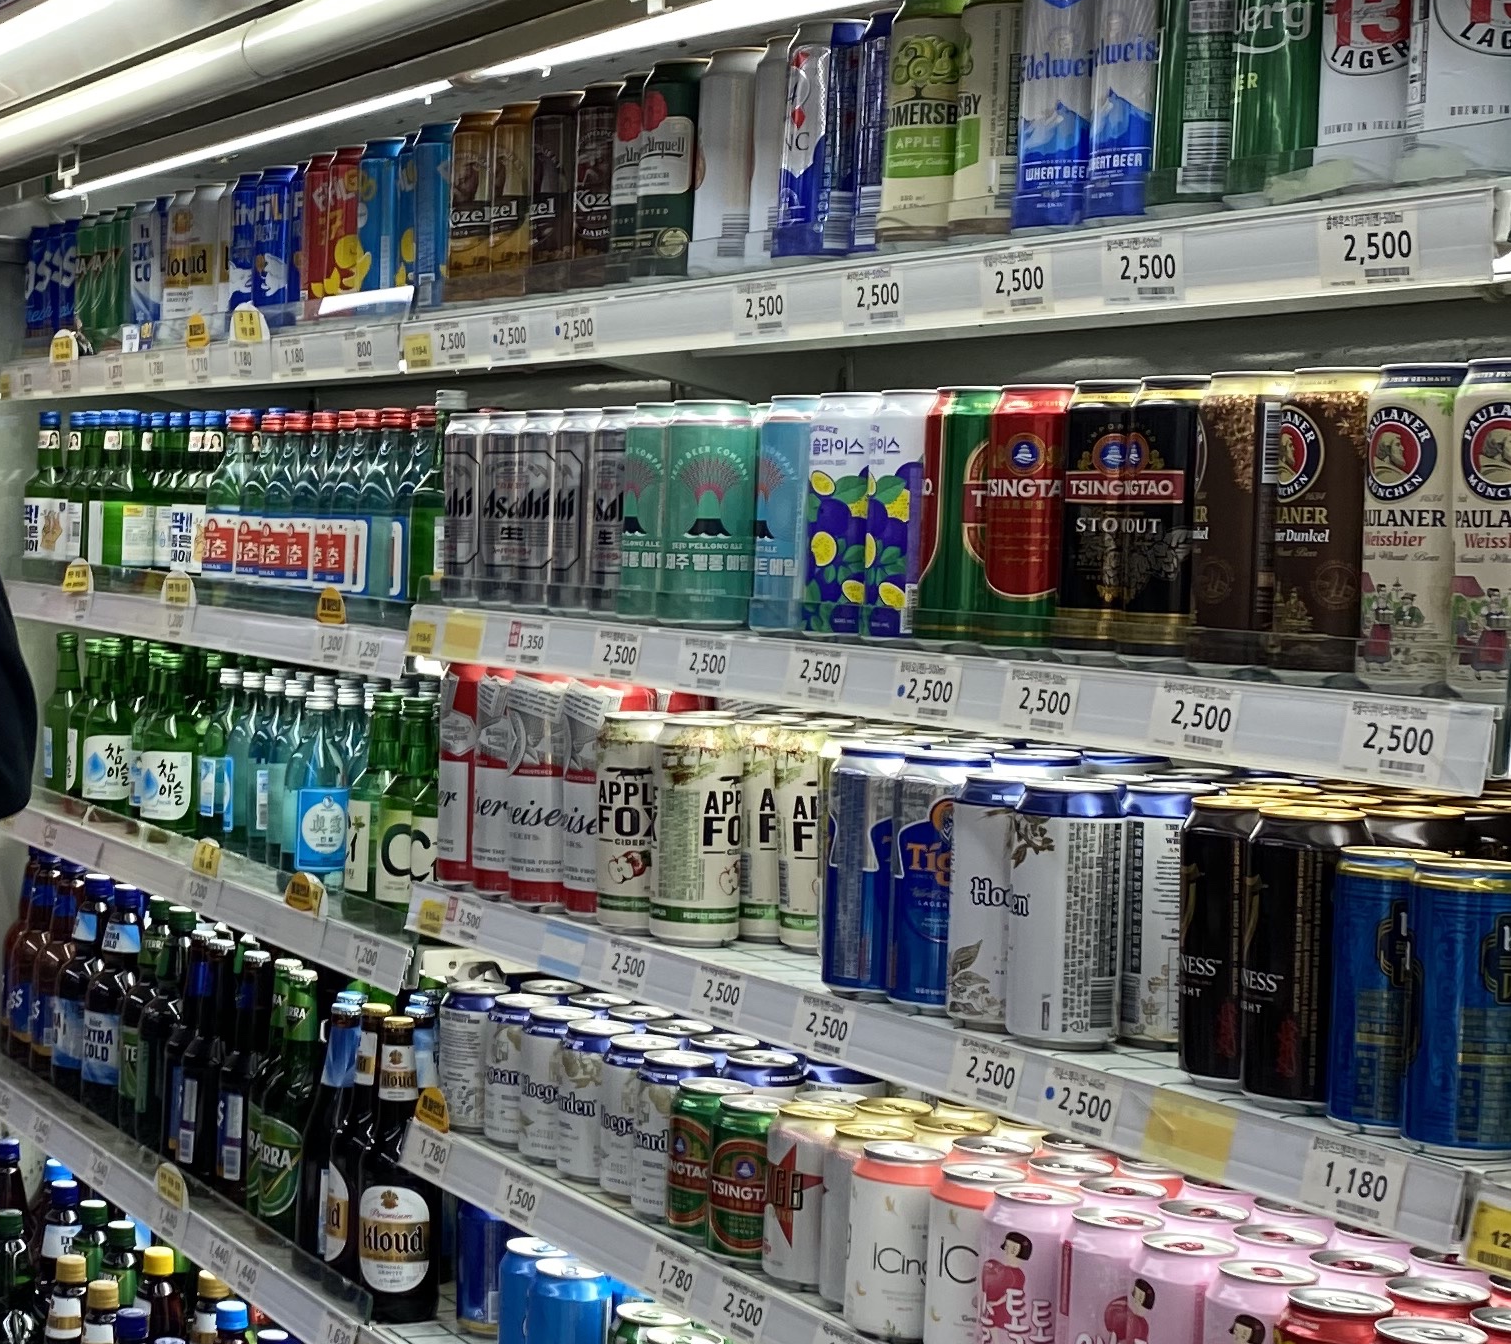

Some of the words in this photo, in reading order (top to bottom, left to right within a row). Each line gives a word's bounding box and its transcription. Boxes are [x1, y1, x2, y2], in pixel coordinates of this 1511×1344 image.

[895, 136, 941, 149] APPLE
[1025, 165, 1061, 182] WHEAT
[1112, 152, 1143, 168] BEER
[1342, 229, 1413, 266] 2,500
[995, 265, 1044, 297] 2,500
[1119, 254, 1177, 282] 2,500
[745, 295, 784, 319] 2,500
[856, 282, 900, 310] 2,500
[440, 331, 466, 351] 2,500
[499, 326, 526, 347] 2,500
[563, 318, 594, 342] 2,500
[356, 341, 372, 358] 800
[597, 530, 614, 546] 生
[1285, 529, 1330, 543] Dunkel
[519, 633, 544, 651] 1,350
[603, 644, 638, 666] 2,500
[688, 651, 726, 675] 2,500
[799, 658, 841, 686] 2,500
[906, 678, 953, 704] 2,500
[1018, 686, 1071, 716] 2,500
[1170, 700, 1232, 733] 2,500
[1362, 722, 1434, 756] 2,500
[158, 780, 185, 806] 이슬
[598, 805, 658, 841] FOX
[610, 952, 646, 978] 2,500
[702, 979, 740, 1006] 2,500
[805, 1011, 849, 1043] 2,500
[965, 1055, 1016, 1090] 2,500
[1057, 1086, 1113, 1123] 2,500
[420, 1138, 446, 1165] 1,780
[1325, 1160, 1389, 1203] 1,180
[505, 1184, 536, 1212] 1,500
[657, 1260, 693, 1292] 1,780
[722, 1292, 763, 1327] 2,500
